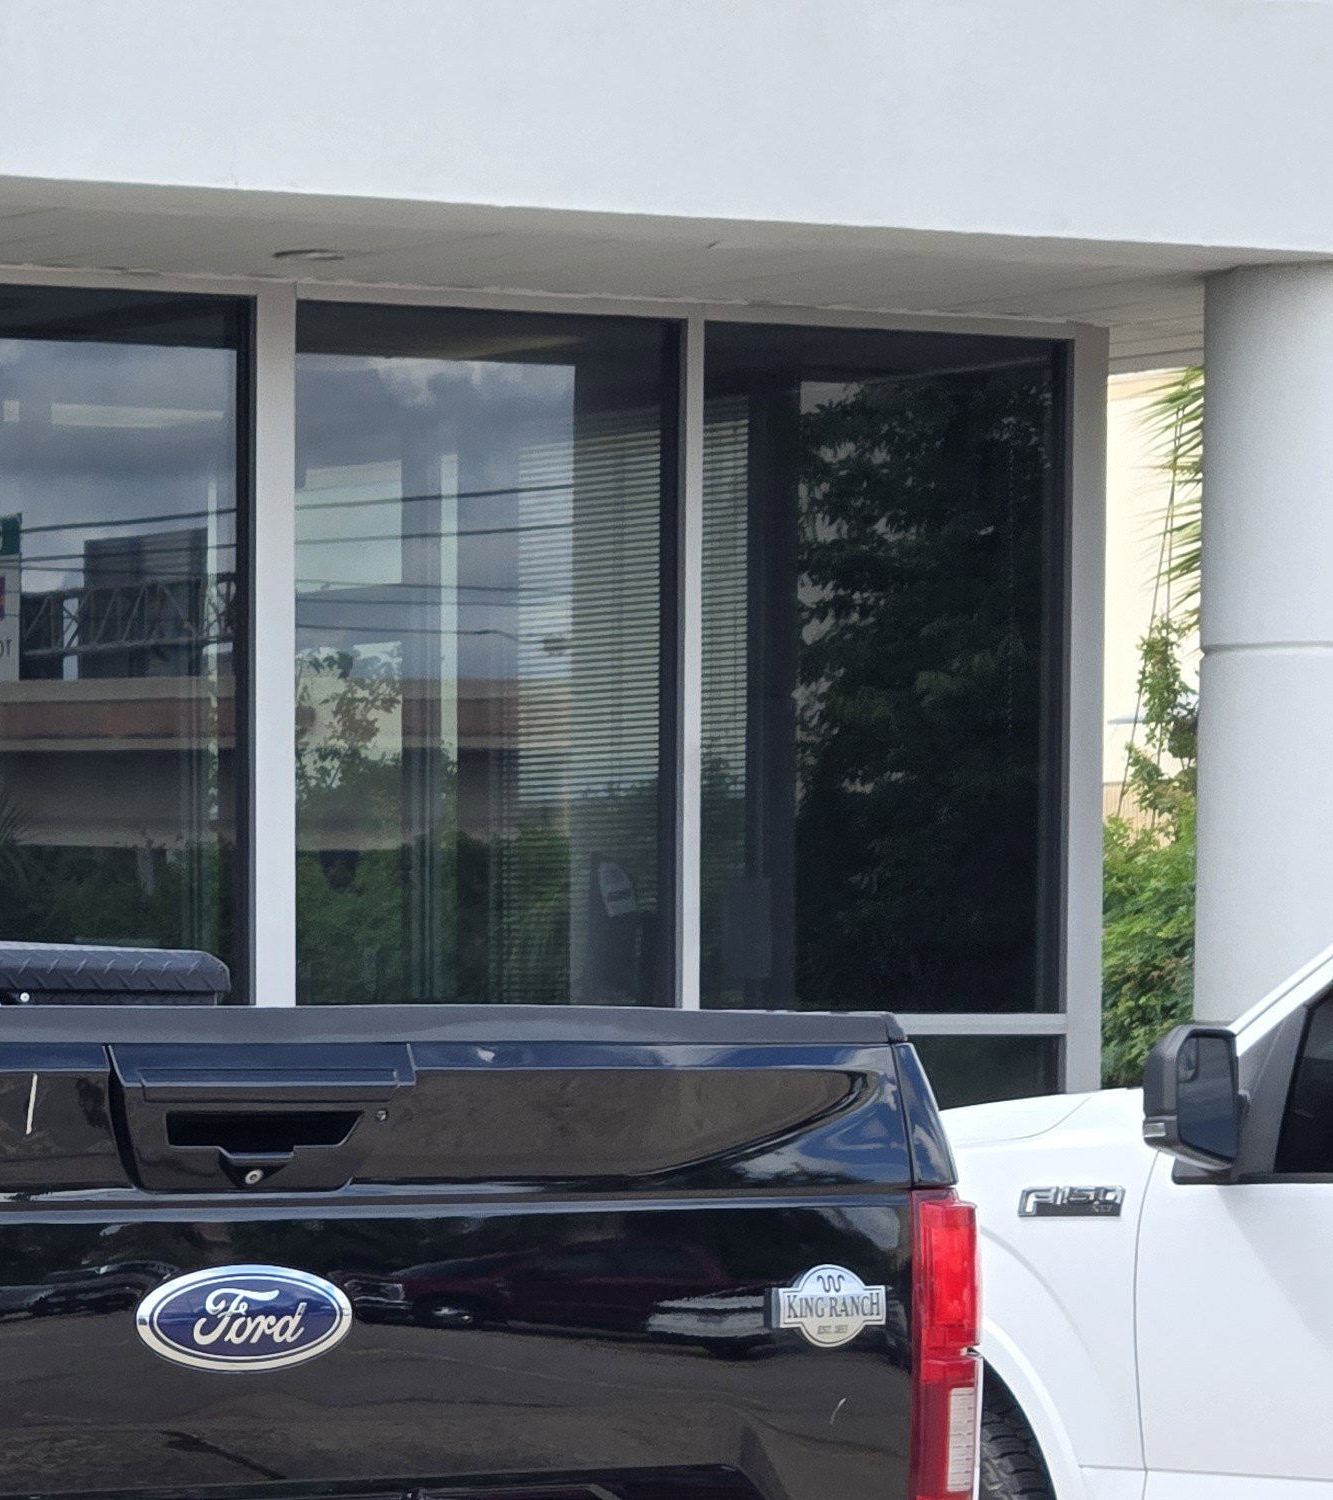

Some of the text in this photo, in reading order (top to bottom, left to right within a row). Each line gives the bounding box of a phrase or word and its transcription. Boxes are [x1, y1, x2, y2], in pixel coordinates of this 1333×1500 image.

[193, 1287, 309, 1346] Ford
[786, 1292, 881, 1319] KING RANCH
